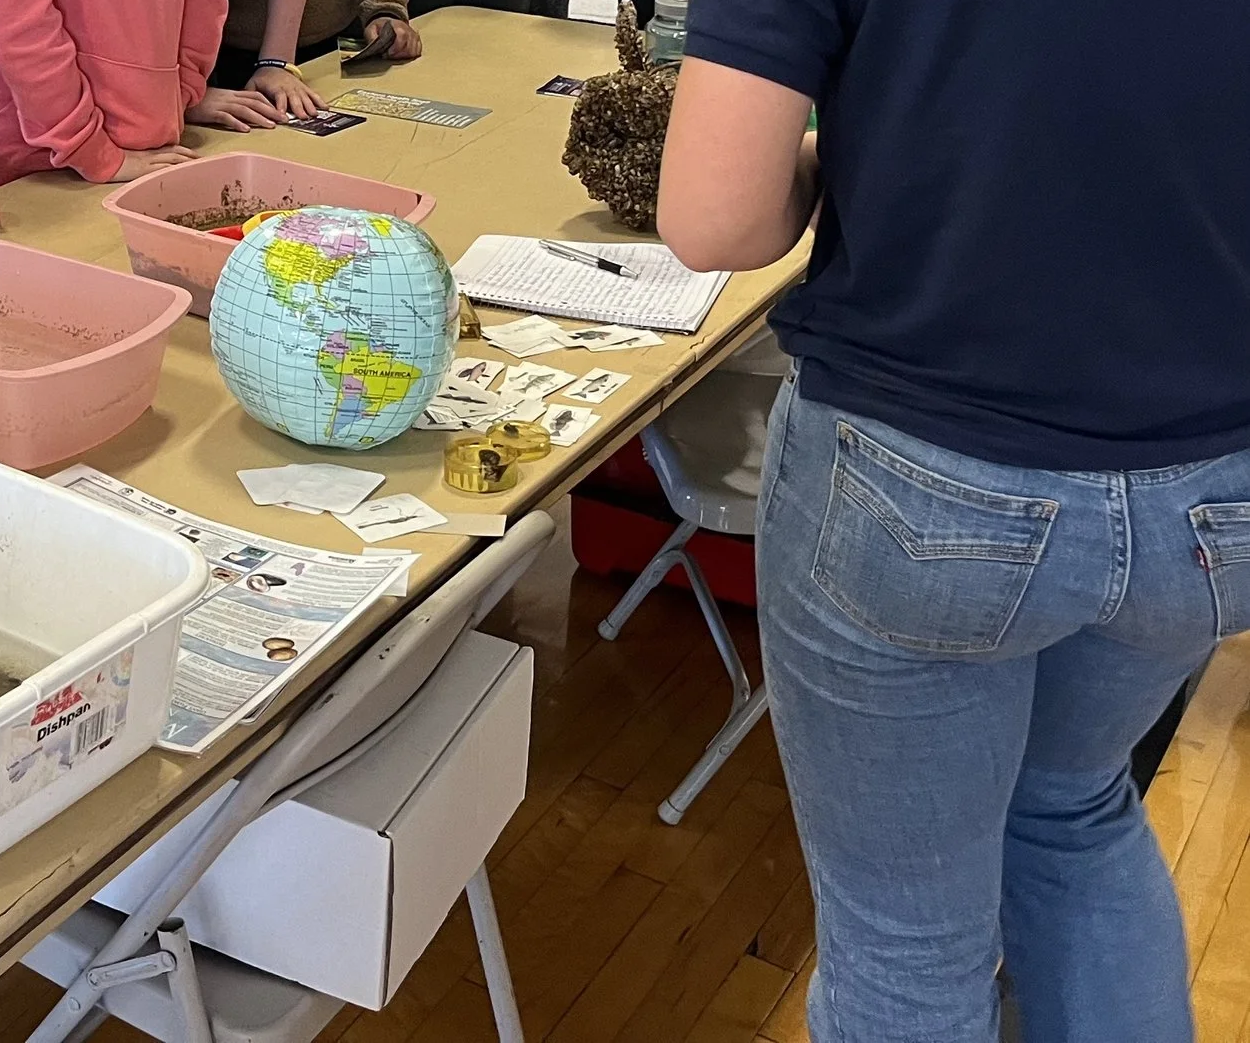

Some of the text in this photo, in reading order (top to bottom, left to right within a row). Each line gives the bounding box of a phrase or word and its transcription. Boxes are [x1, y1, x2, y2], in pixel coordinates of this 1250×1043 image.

[353, 367, 412, 378] SOUTH AMERICA
[36, 702, 91, 742] Dishpan
